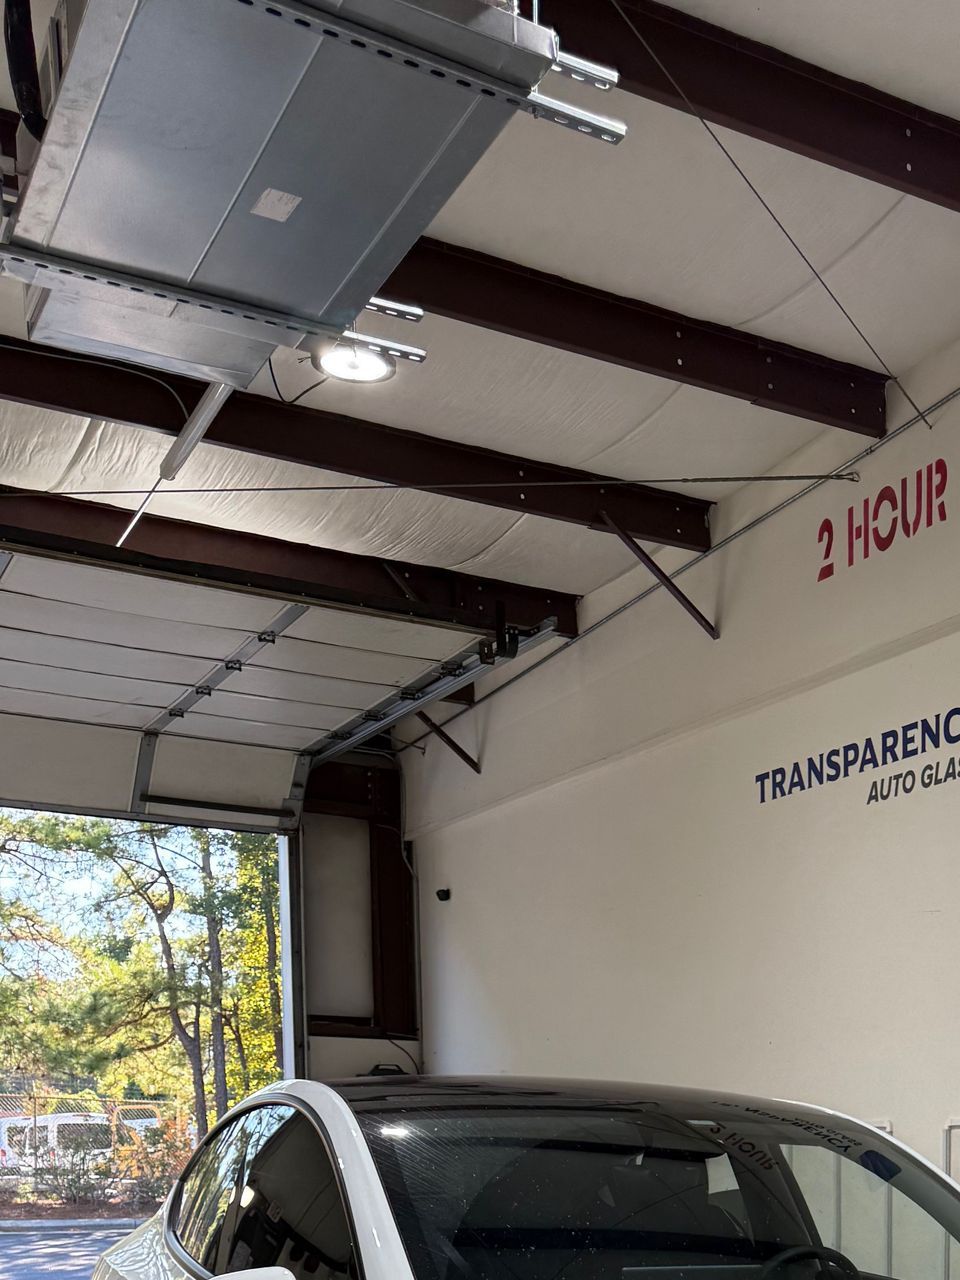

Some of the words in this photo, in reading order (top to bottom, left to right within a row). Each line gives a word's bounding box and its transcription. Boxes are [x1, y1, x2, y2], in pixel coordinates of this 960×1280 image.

[817, 518, 834, 582] 2
[848, 458, 948, 567] HOUR
[866, 770, 916, 805] AUTO
